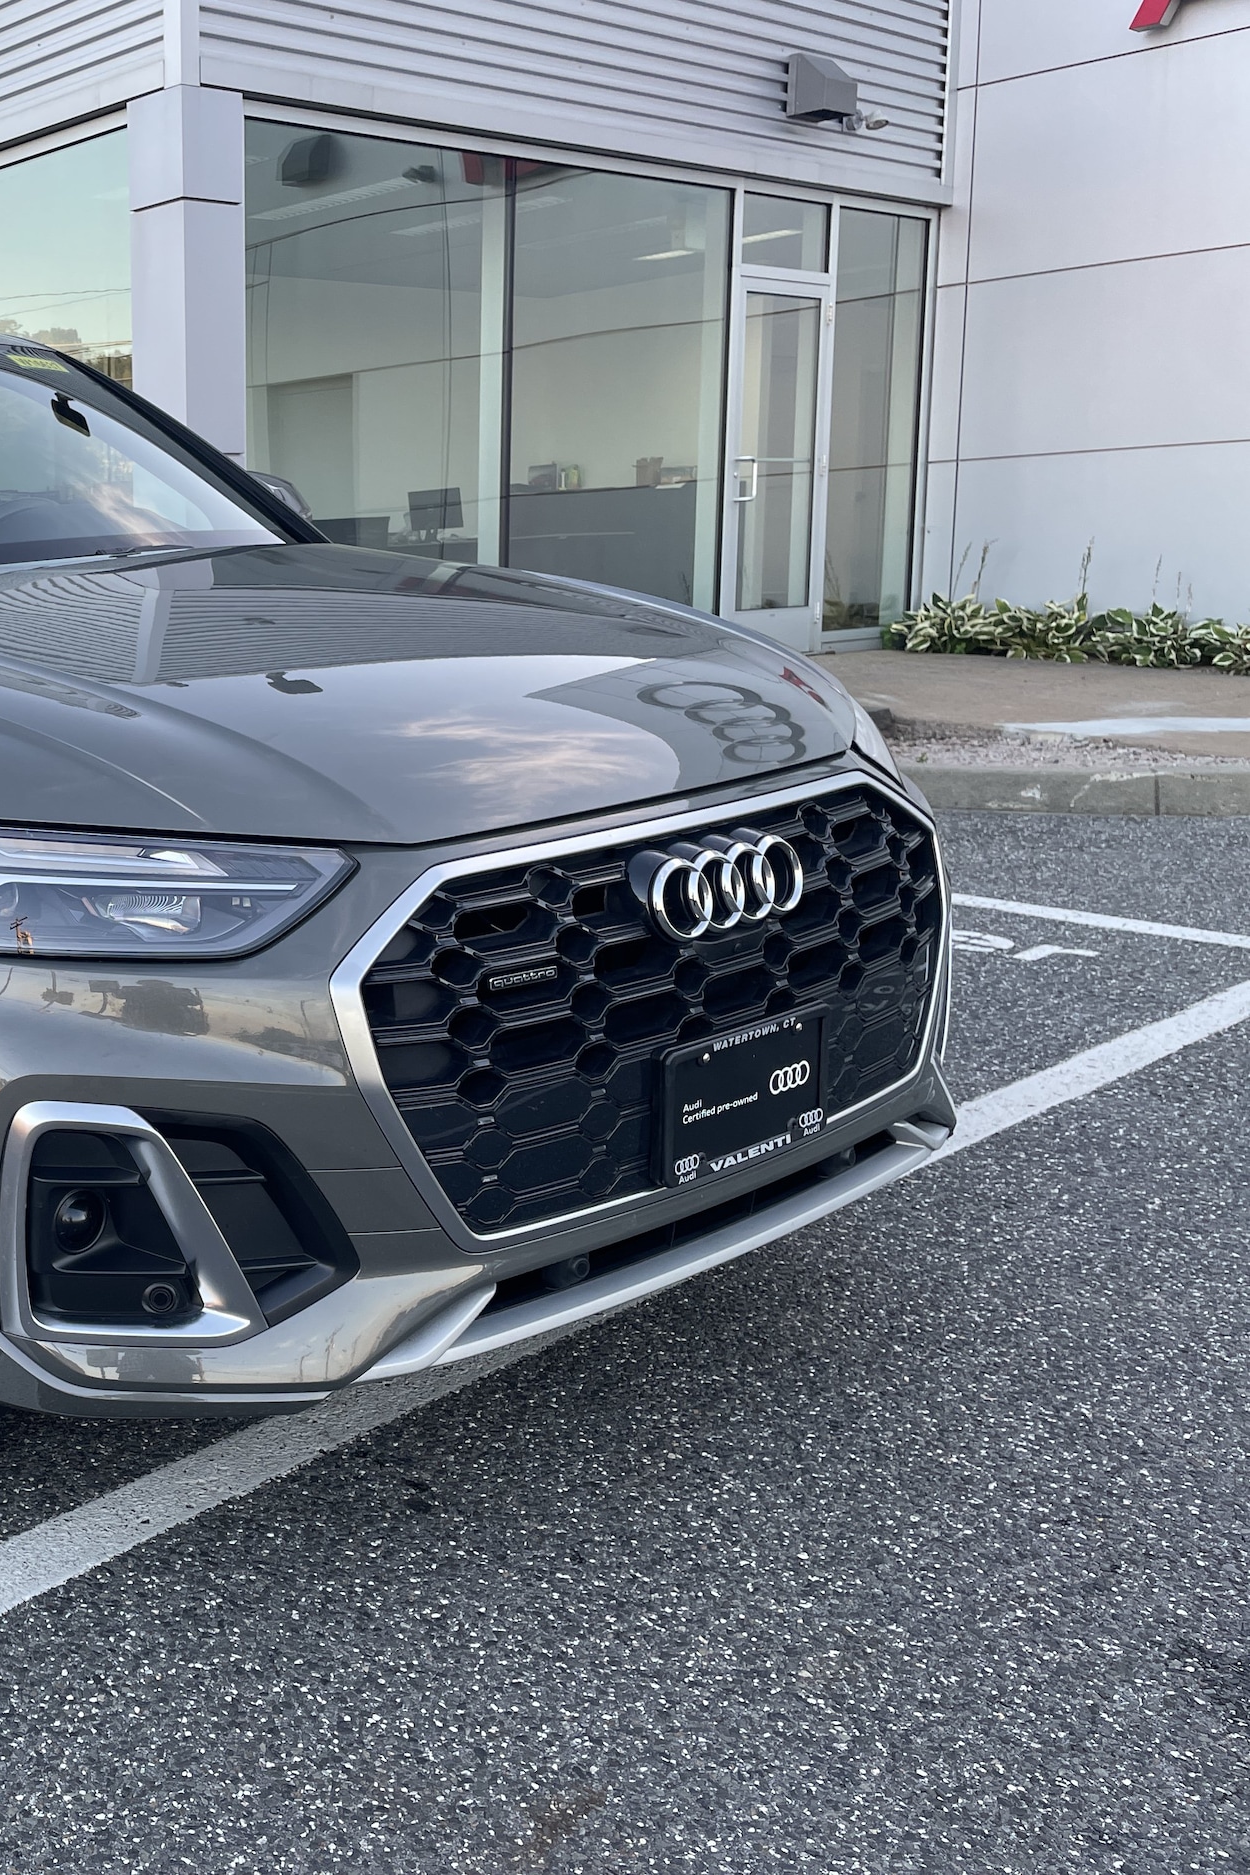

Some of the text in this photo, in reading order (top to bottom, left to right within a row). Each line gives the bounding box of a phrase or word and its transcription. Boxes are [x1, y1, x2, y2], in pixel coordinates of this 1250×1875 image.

[493, 969, 555, 987] quattro
[713, 1016, 796, 1052] WATERTOWN, CT
[682, 1099, 703, 1114] Audi
[682, 1092, 759, 1124] Certified pre-owned
[803, 1123, 821, 1137] Audi
[709, 1133, 792, 1172] VALENTI
[678, 1171, 697, 1185] Audi
